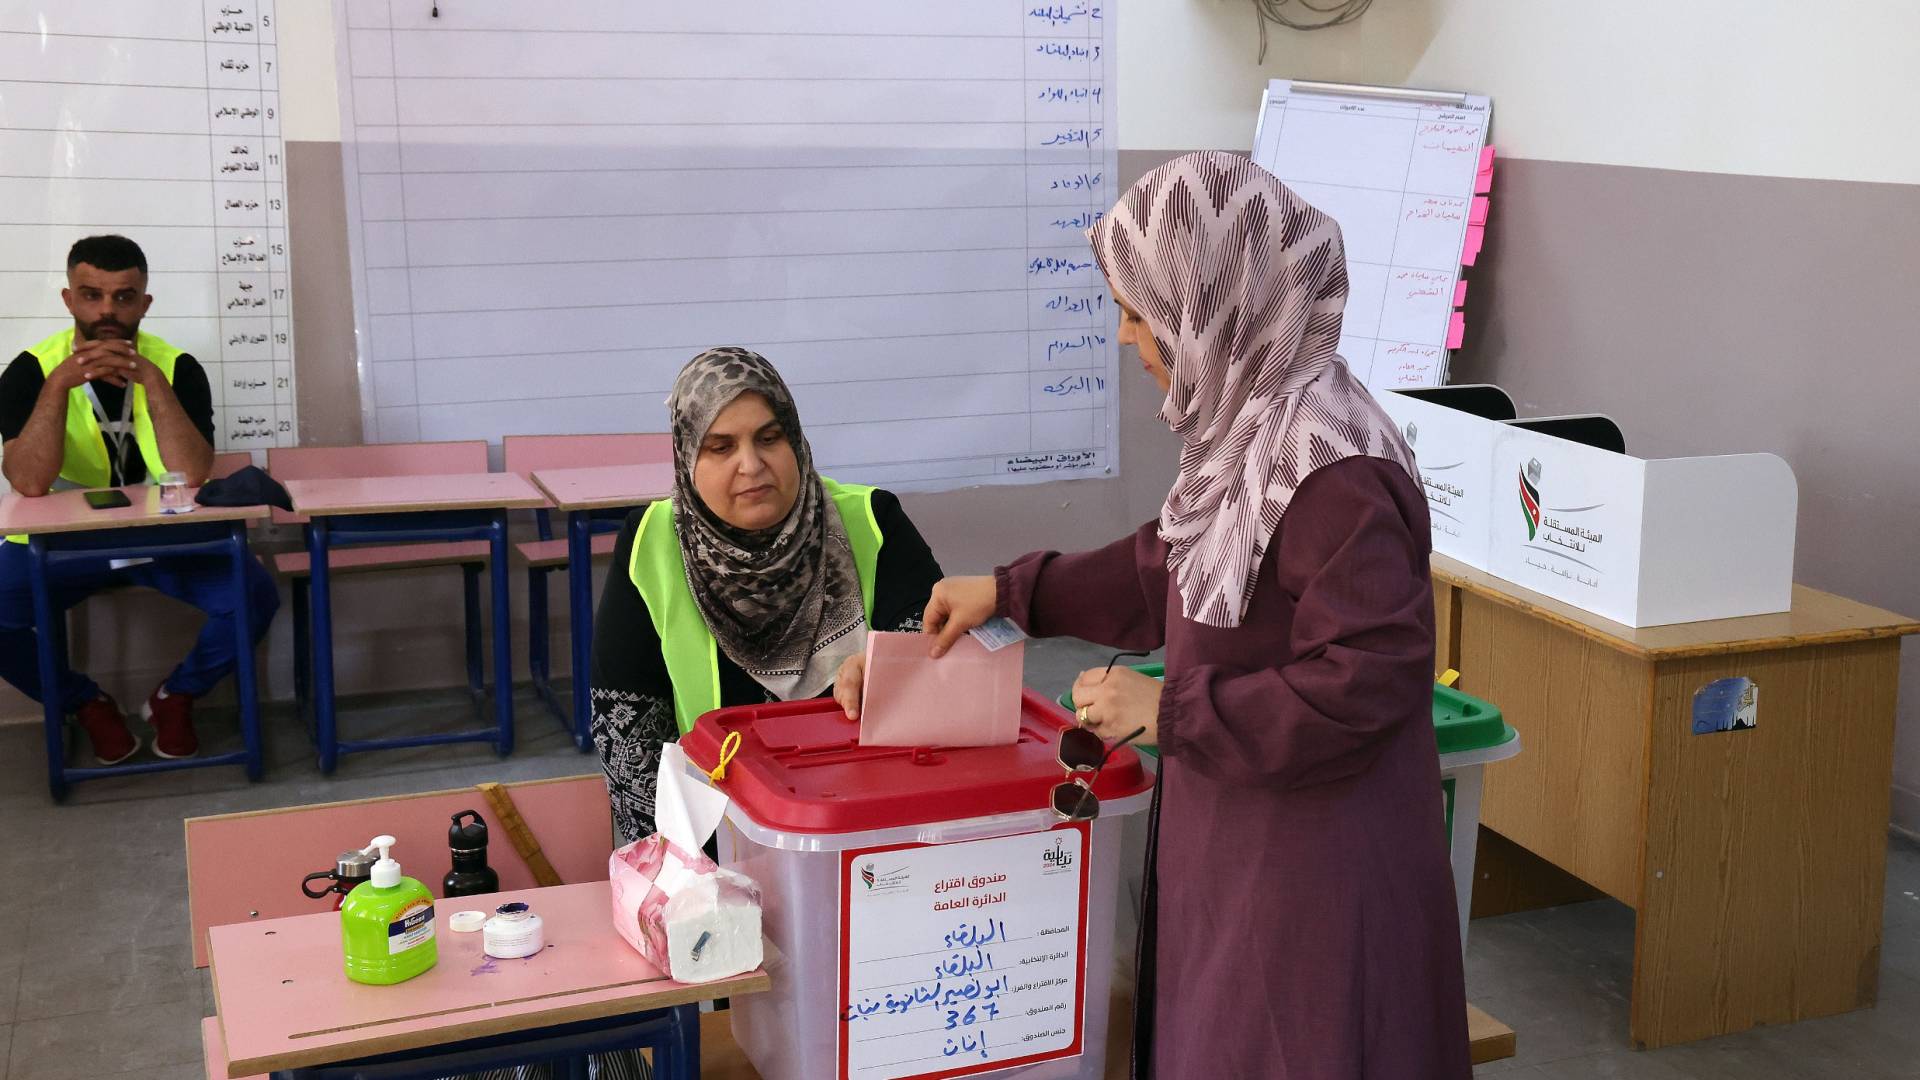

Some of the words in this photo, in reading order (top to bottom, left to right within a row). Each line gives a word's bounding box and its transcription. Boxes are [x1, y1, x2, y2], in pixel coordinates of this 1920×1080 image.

[1091, 7, 1103, 19] 2
[263, 15, 270, 27] 5
[264, 61, 272, 73] 7
[1092, 87, 1102, 104] 4
[267, 108, 274, 119] 9
[1091, 128, 1102, 142] 5
[269, 154, 278, 165] 11
[1092, 172, 1102, 186] 6
[269, 199, 281, 210] 13
[271, 244, 283, 255] 15
[273, 289, 284, 300] 17
[275, 333, 287, 344] 19
[277, 376, 288, 388] 21
[279, 421, 291, 432] 23
[1543, 515, 1581, 537] المستقلة
[1542, 532, 1586, 553] للانتخاب
[1581, 529, 1603, 544] الهيئة
[934, 876, 965, 894] اقتراع
[967, 872, 1007, 889] صندوق
[934, 897, 969, 912] العامة
[972, 892, 1007, 909] الدائرة
[944, 917, 1006, 949] البلقاء
[935, 949, 993, 980] البلقاء
[945, 1001, 1000, 1031] 367
